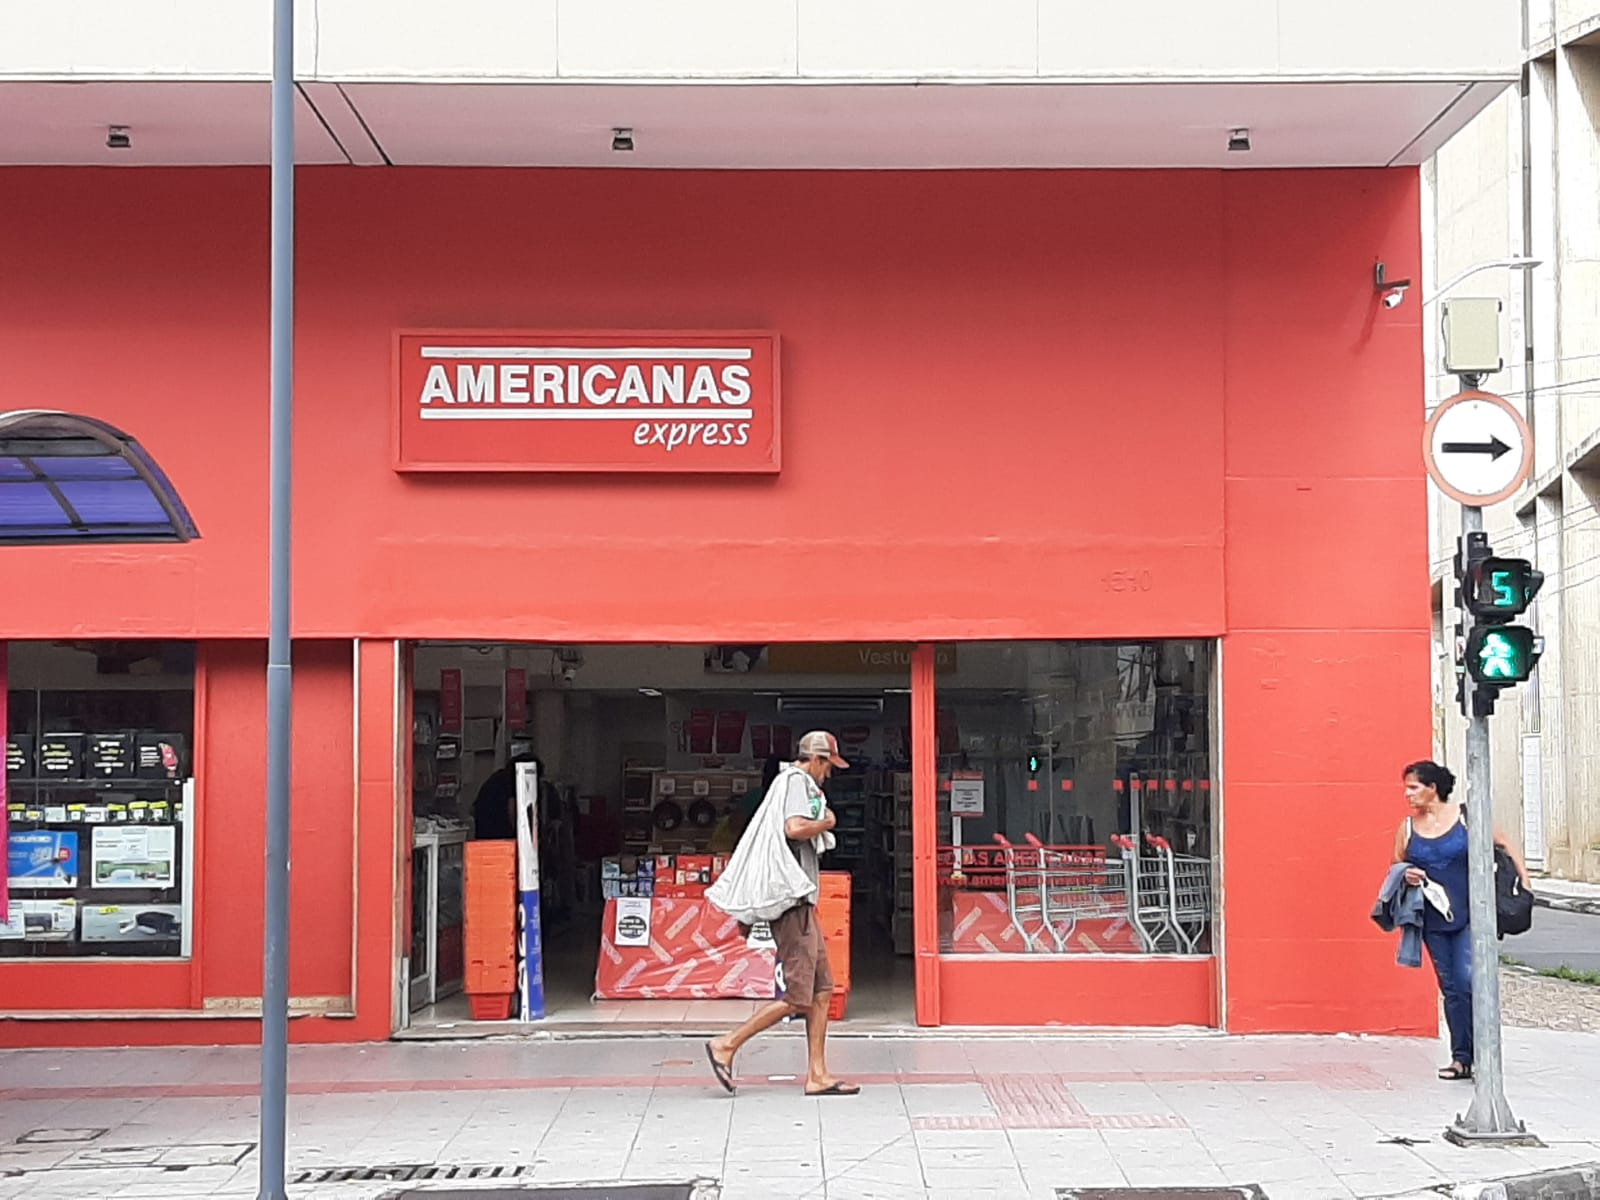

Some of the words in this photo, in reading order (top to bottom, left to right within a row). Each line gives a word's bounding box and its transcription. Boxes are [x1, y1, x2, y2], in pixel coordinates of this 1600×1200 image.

[419, 363, 752, 406] AMERICANAS
[633, 421, 751, 451] express
[1491, 570, 1513, 606] 5
